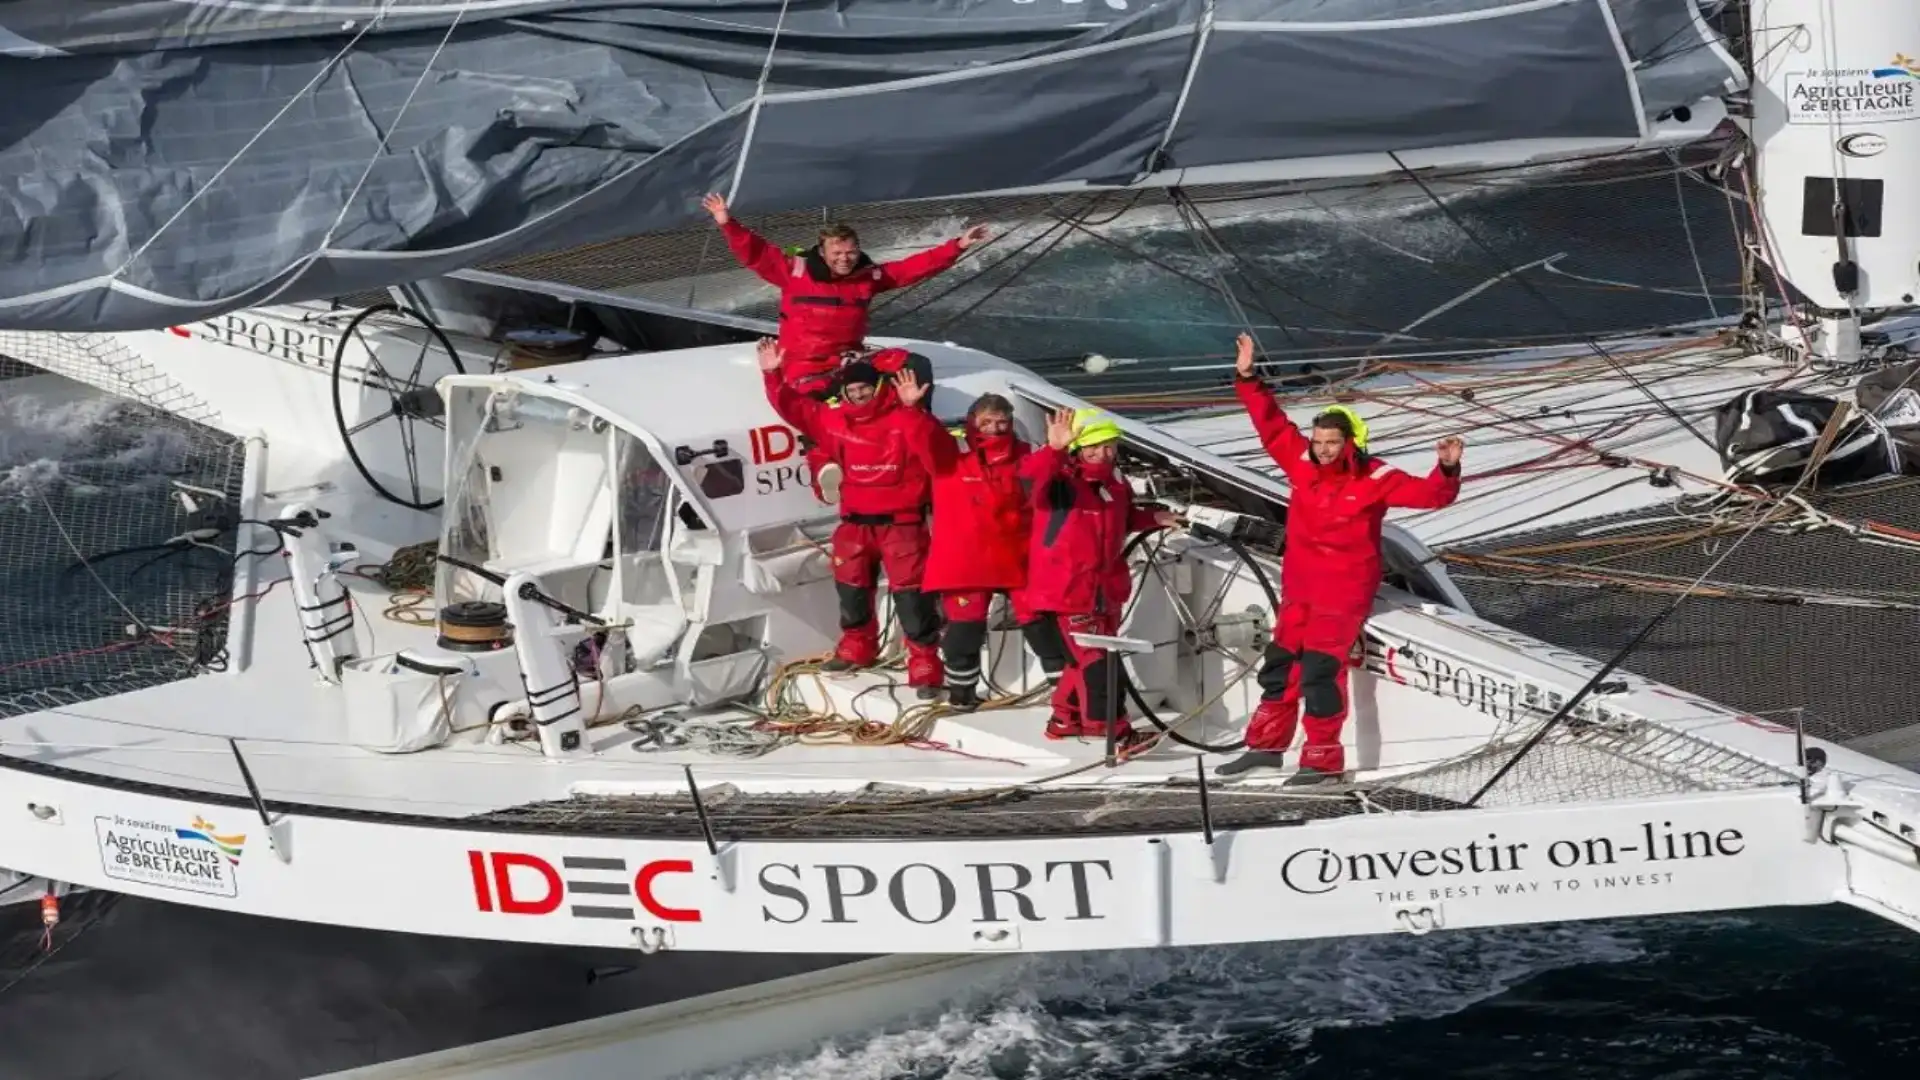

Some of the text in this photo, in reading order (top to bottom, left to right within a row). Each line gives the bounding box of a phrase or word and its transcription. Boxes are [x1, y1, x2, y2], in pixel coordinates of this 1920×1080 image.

[1792, 80, 1914, 101] Agriculteurs
[1801, 94, 1914, 111] de BRETAGNE
[201, 315, 335, 369] SPORT
[749, 424, 814, 465] ID
[756, 463, 813, 496] SPO
[1413, 652, 1518, 724] SPORT
[106, 829, 220, 864] Agriculteurs
[1547, 820, 1746, 869] on-line
[115, 852, 131, 865] de
[132, 852, 223, 880] BRETAGNE
[467, 850, 1114, 925] IDEC SPORT
[1376, 872, 1674, 903] THE BEST WAY TO INVEST
